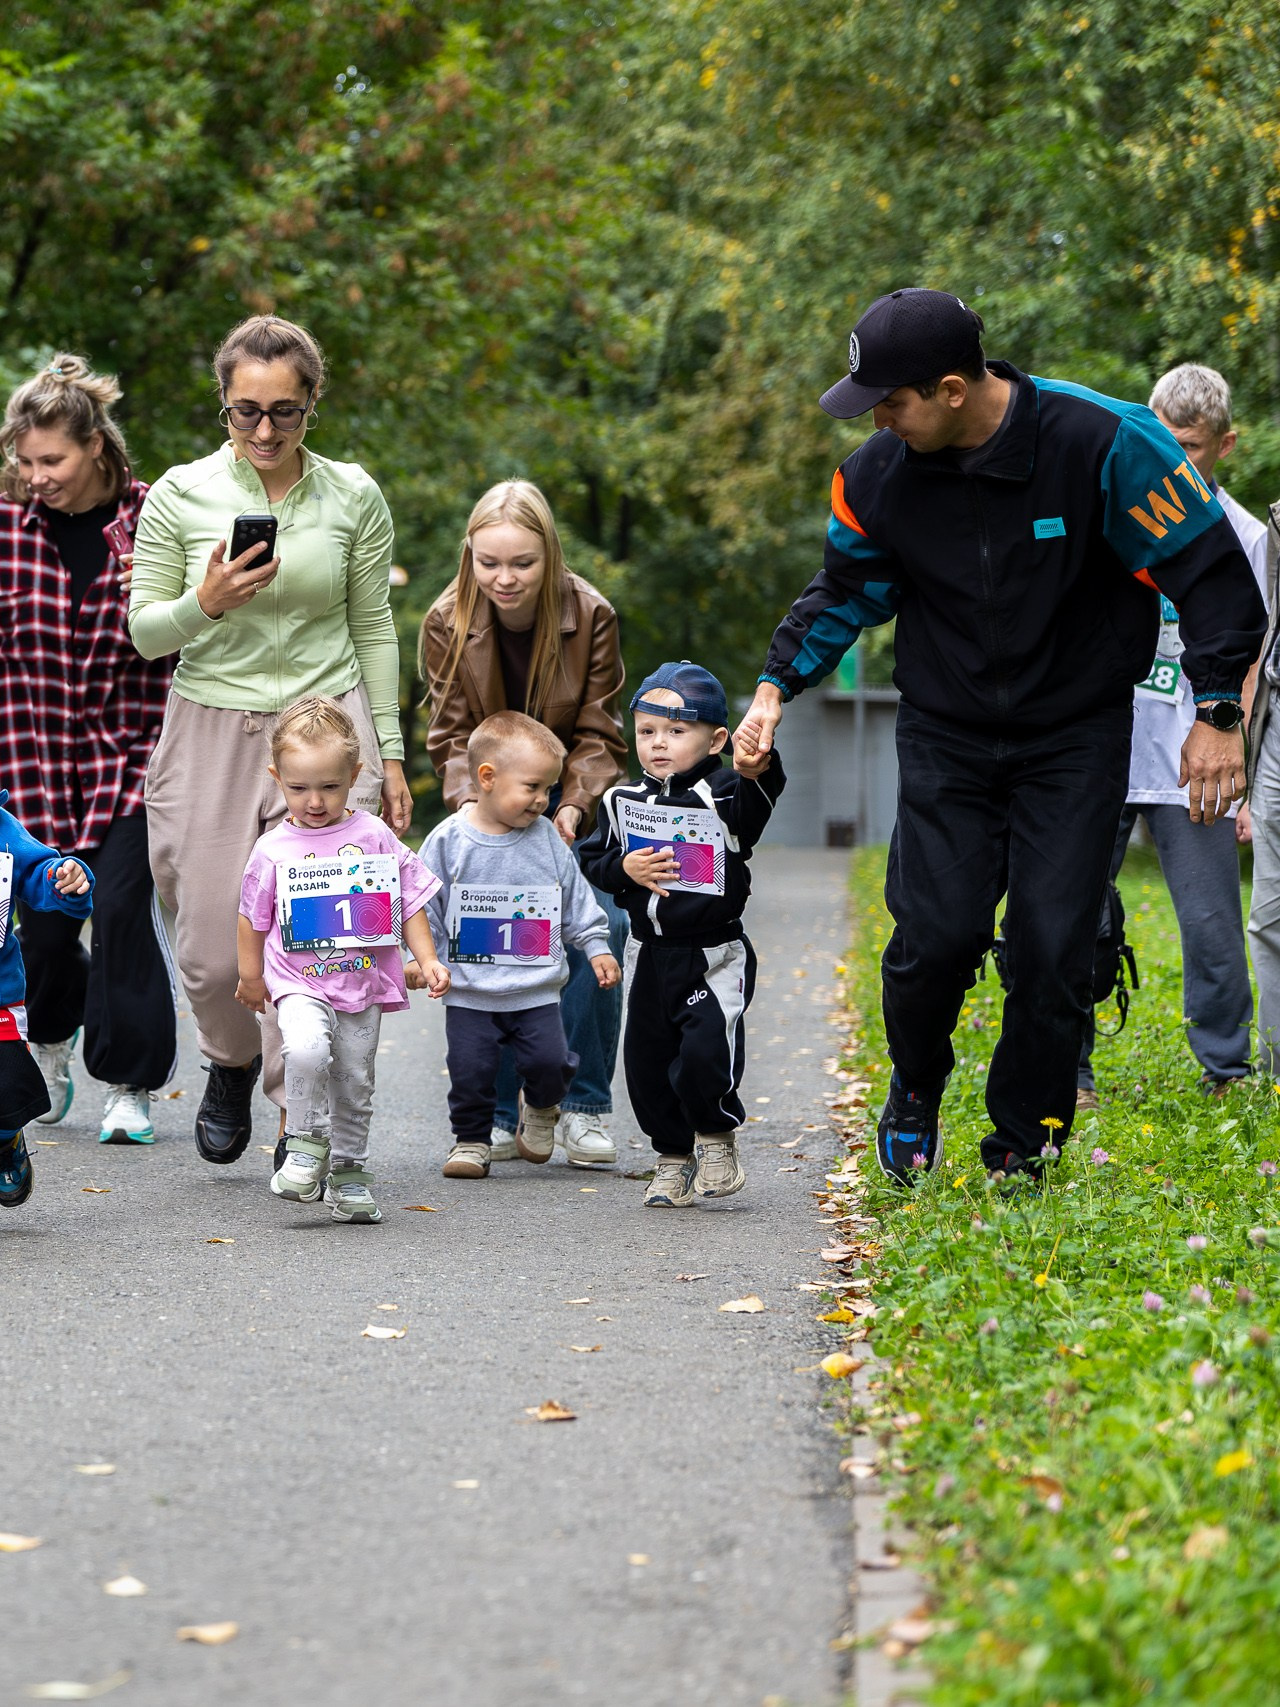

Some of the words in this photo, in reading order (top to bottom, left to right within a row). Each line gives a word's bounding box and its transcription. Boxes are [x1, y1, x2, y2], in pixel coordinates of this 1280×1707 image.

[625, 820, 656, 833] КАЗАНЬ
[289, 882, 330, 892] КАЗАНЬ
[335, 899, 352, 931] 1
[498, 923, 512, 950] 1
[302, 962, 326, 977] MY
[687, 990, 708, 1006] alo
